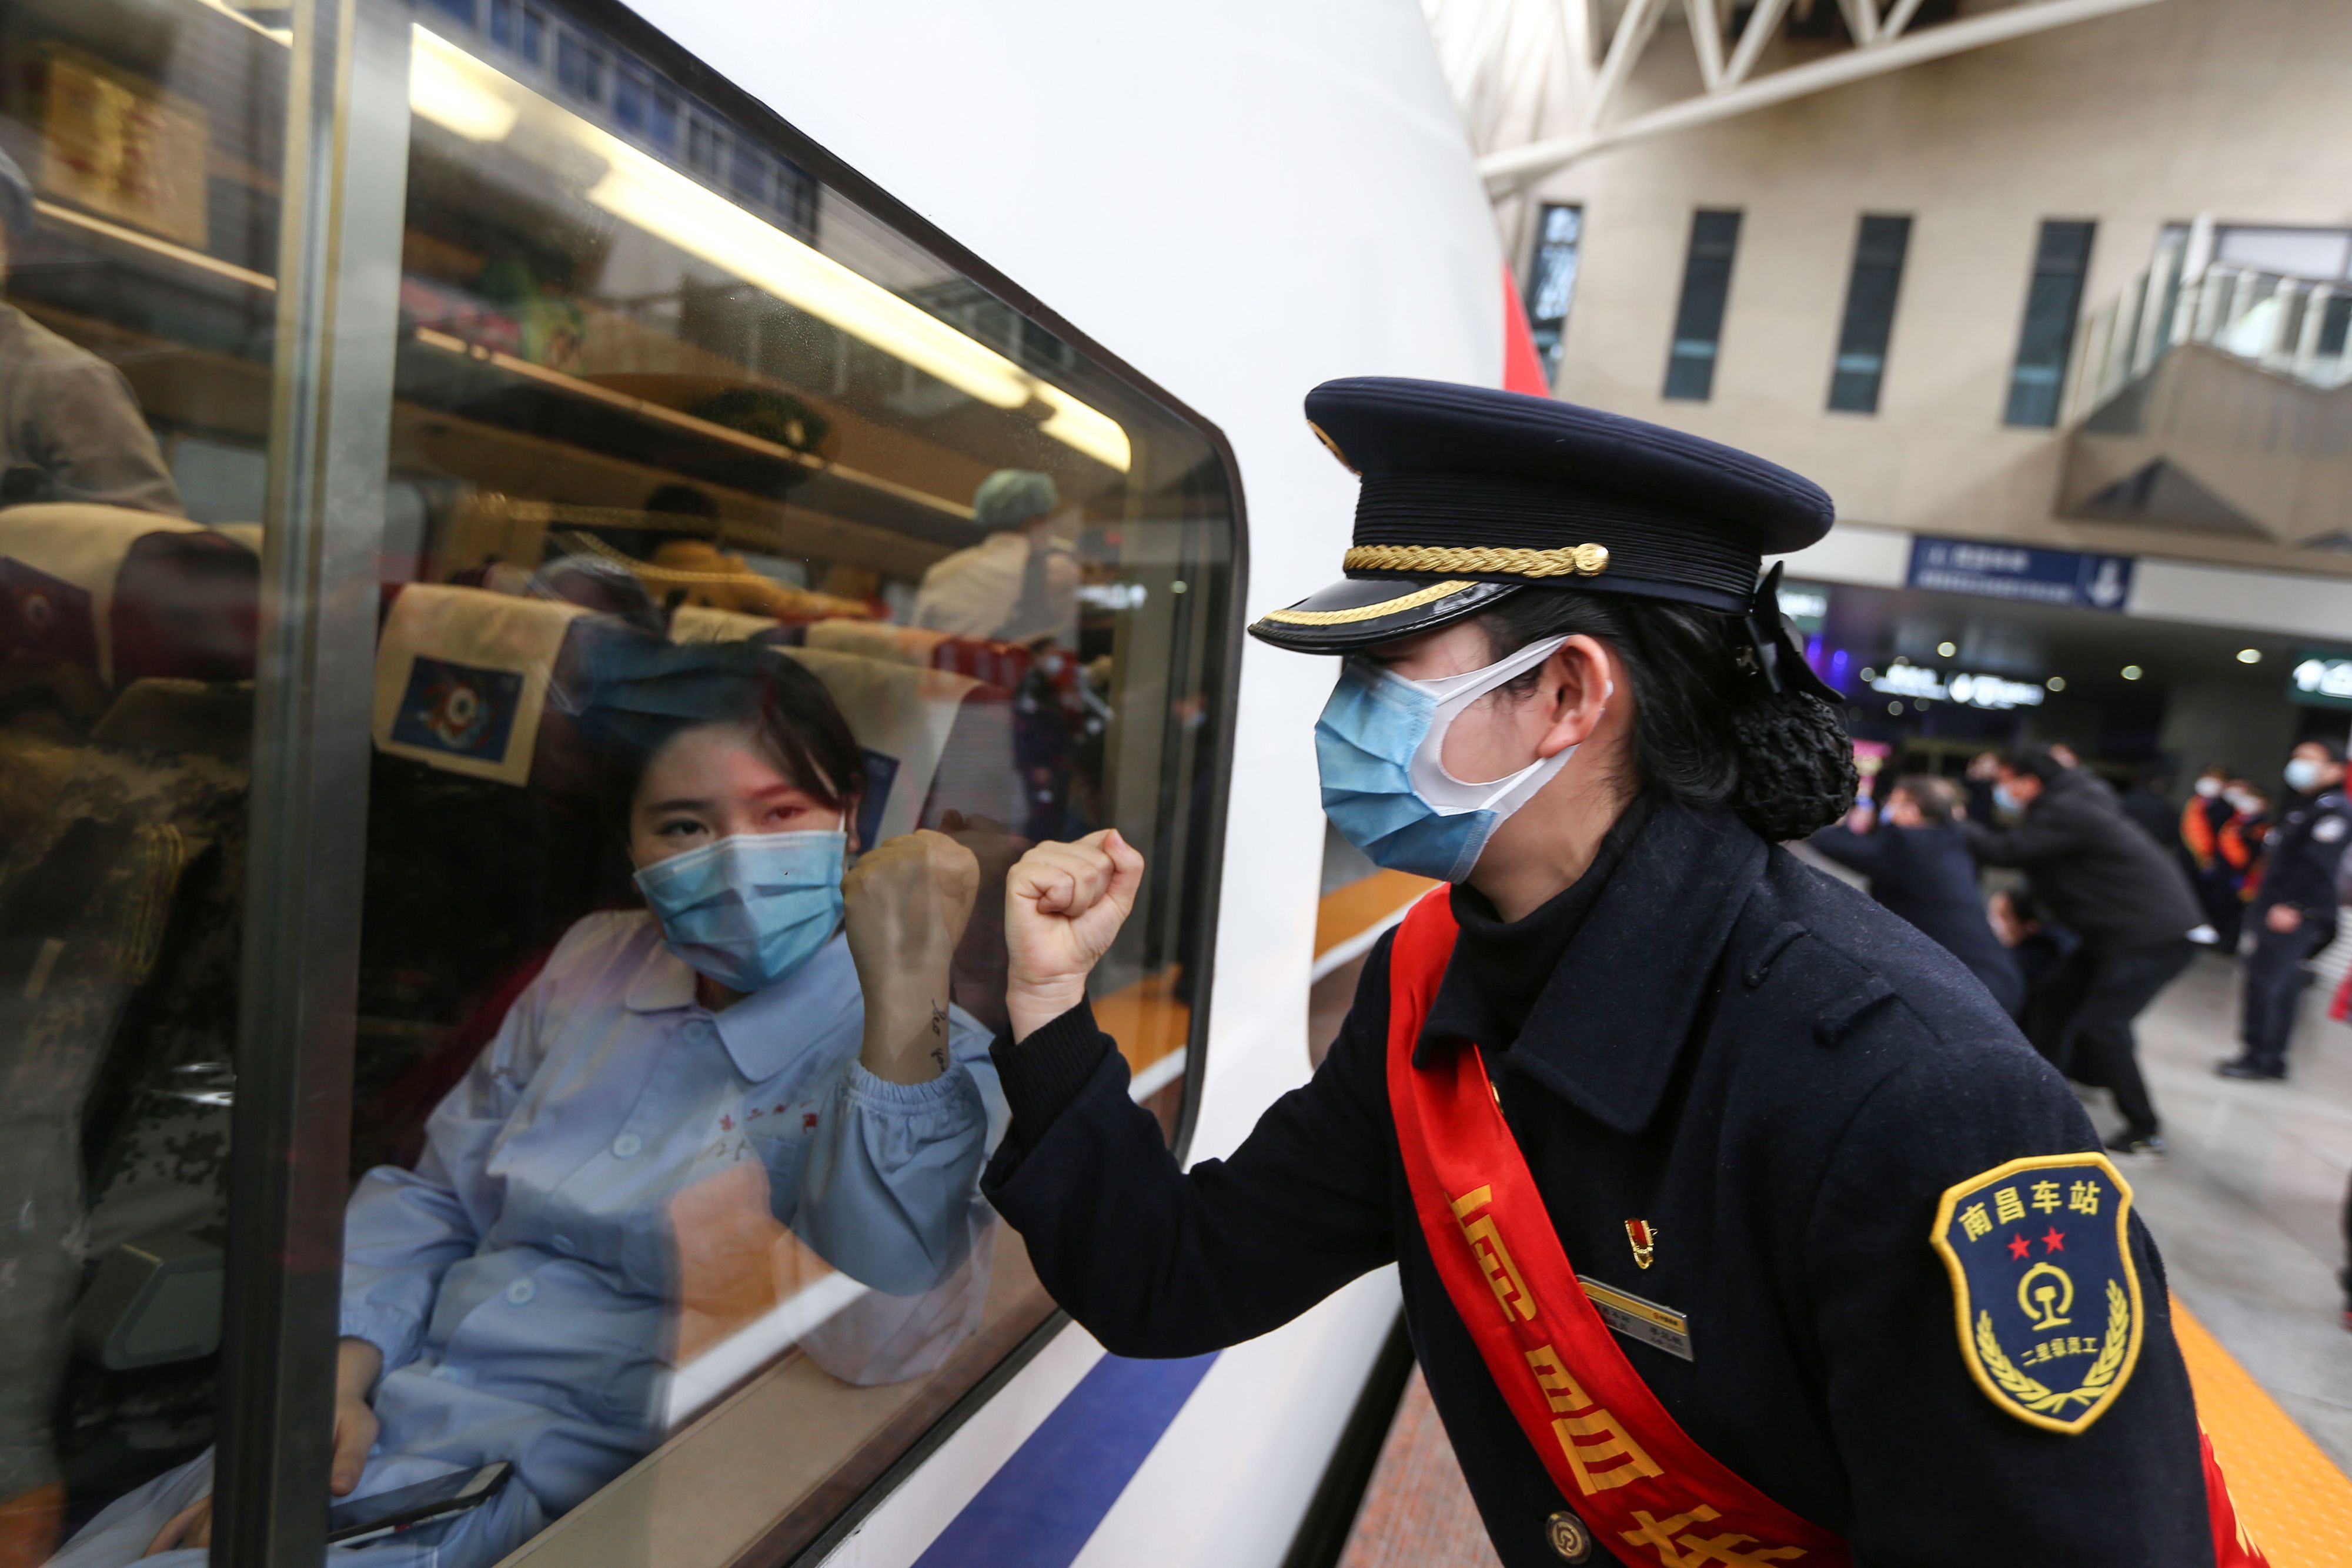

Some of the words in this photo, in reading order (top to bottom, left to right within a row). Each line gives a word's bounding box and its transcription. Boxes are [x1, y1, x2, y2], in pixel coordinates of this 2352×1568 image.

[1959, 1179, 2102, 1242] 南昌车站
[2020, 1336, 2099, 1368] 二星级员工
